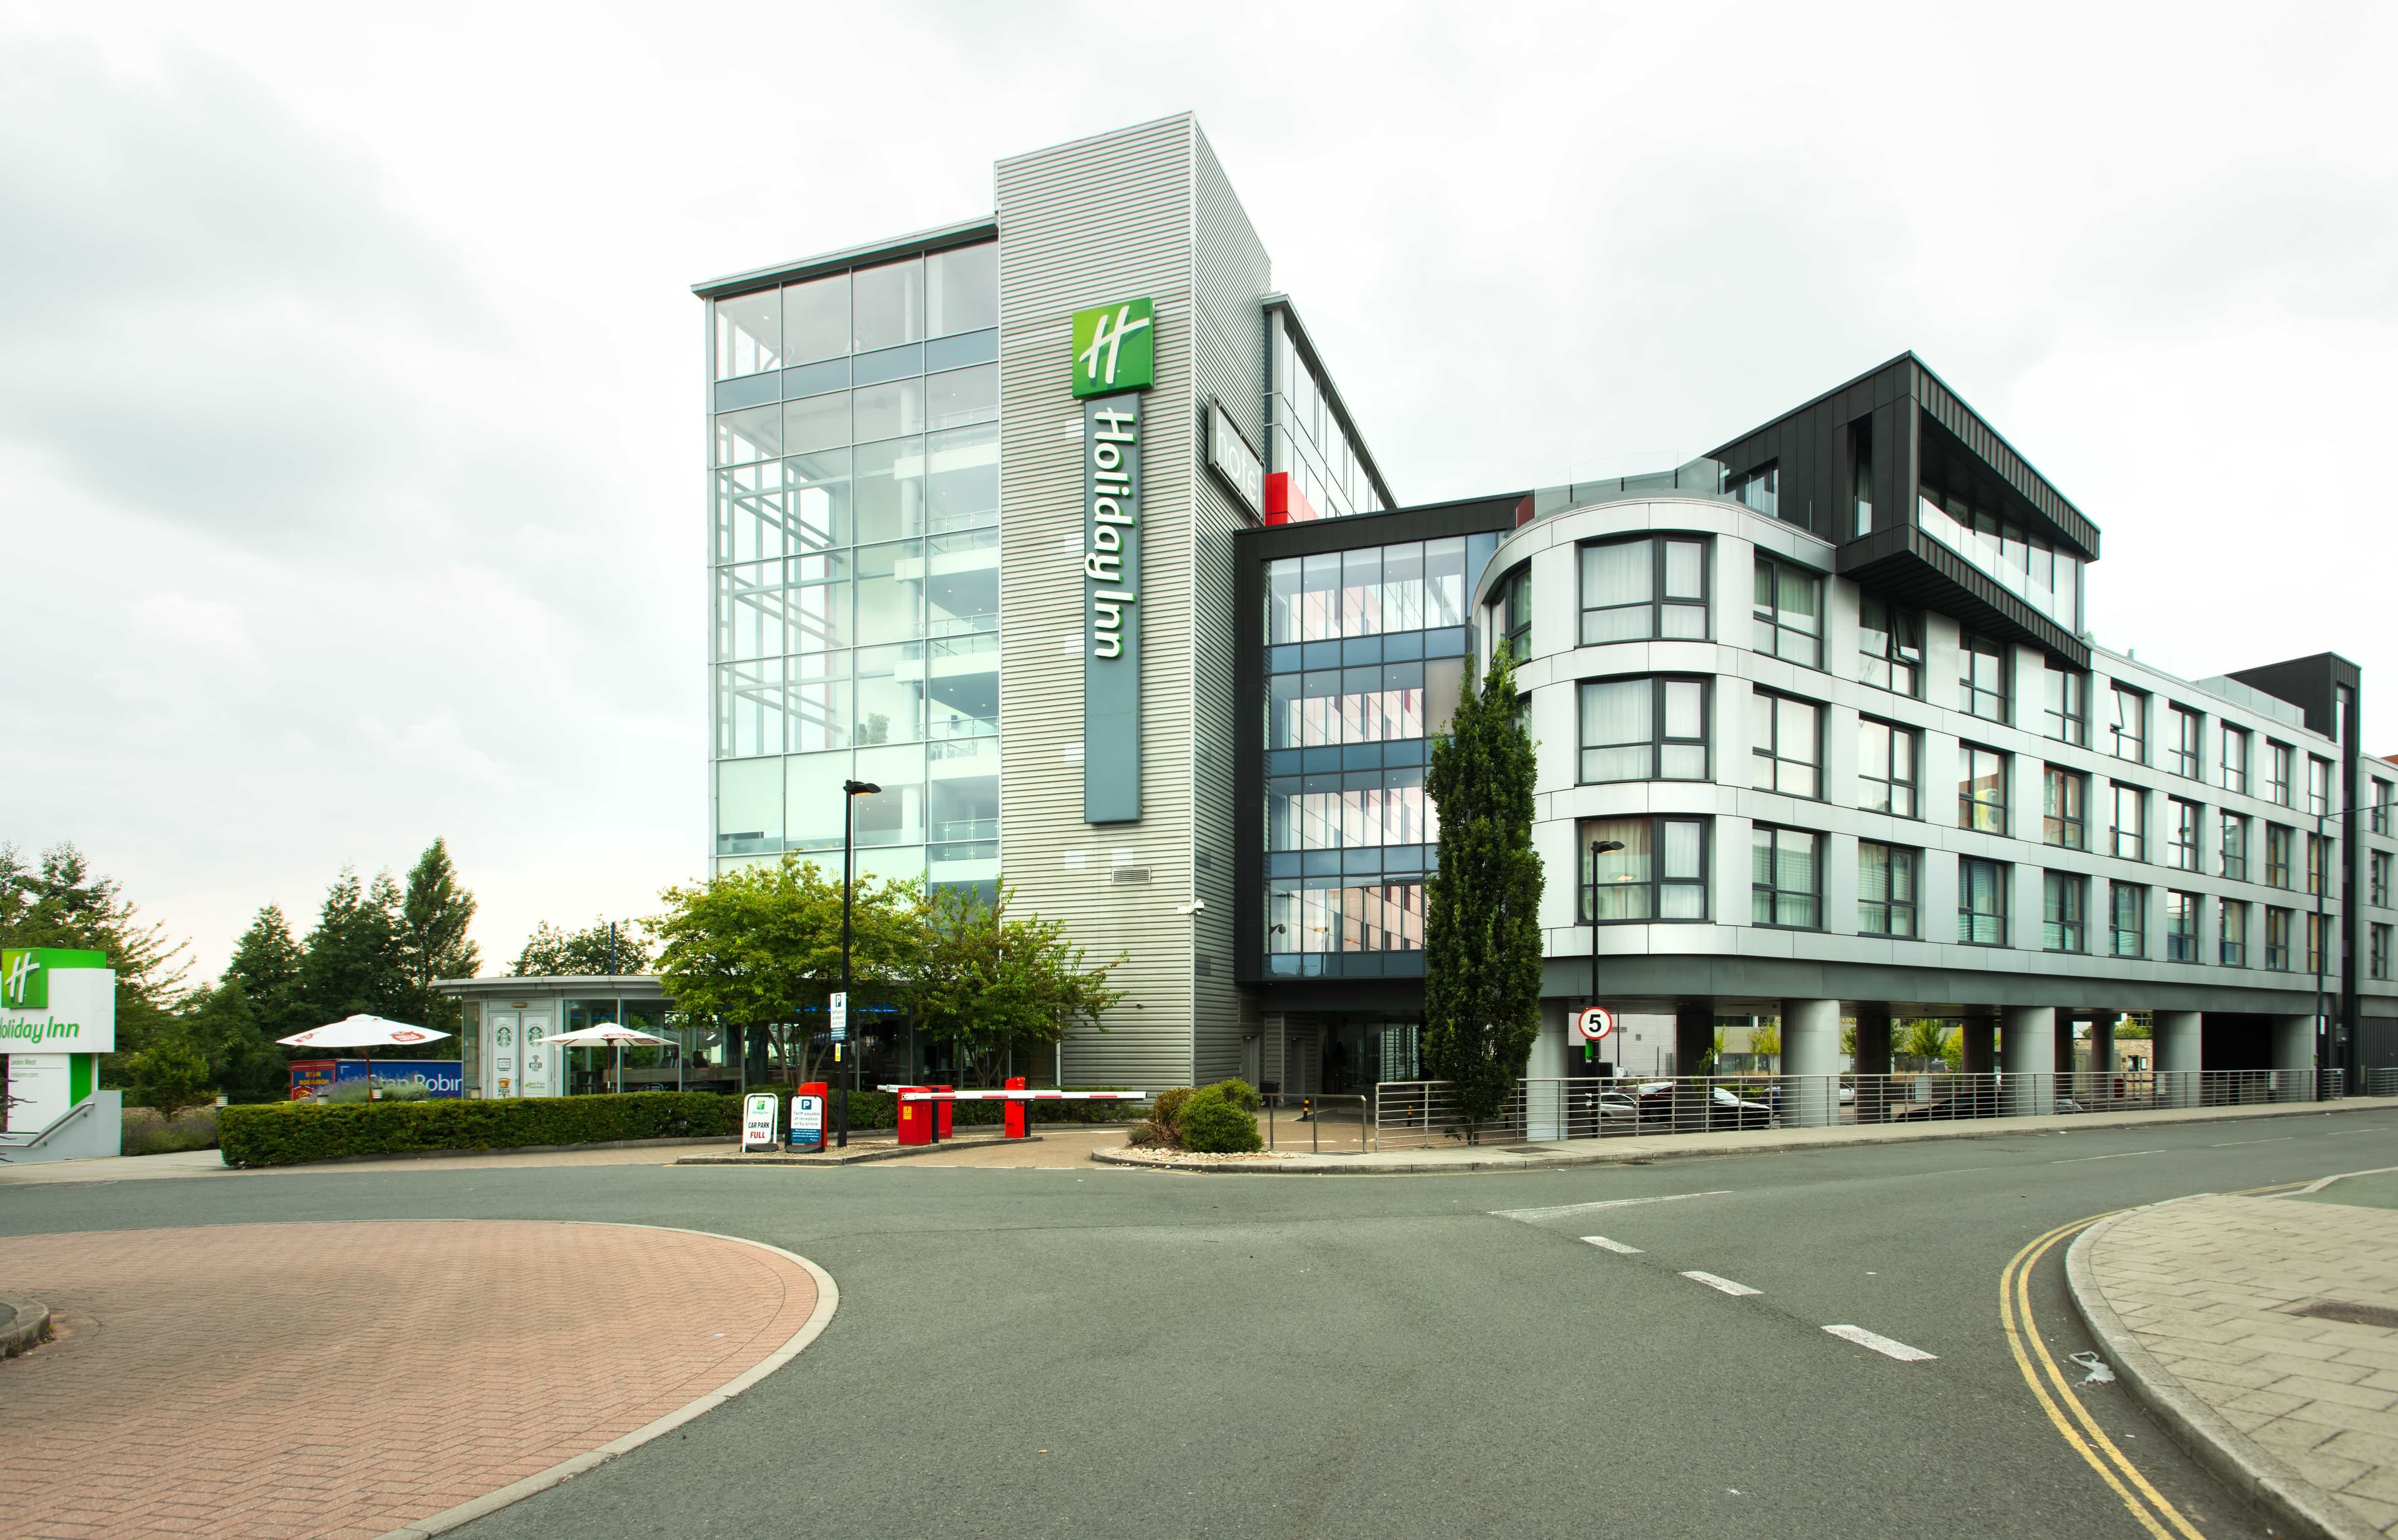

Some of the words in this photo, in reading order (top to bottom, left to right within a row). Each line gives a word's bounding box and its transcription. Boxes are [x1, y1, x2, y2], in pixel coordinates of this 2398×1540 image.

[1084, 407, 1136, 582] Holiday
[1218, 416, 1261, 509] hotel
[1095, 589, 1136, 658] Inn
[46, 1015, 80, 1038] Inn
[1589, 1014, 1602, 1032] 5
